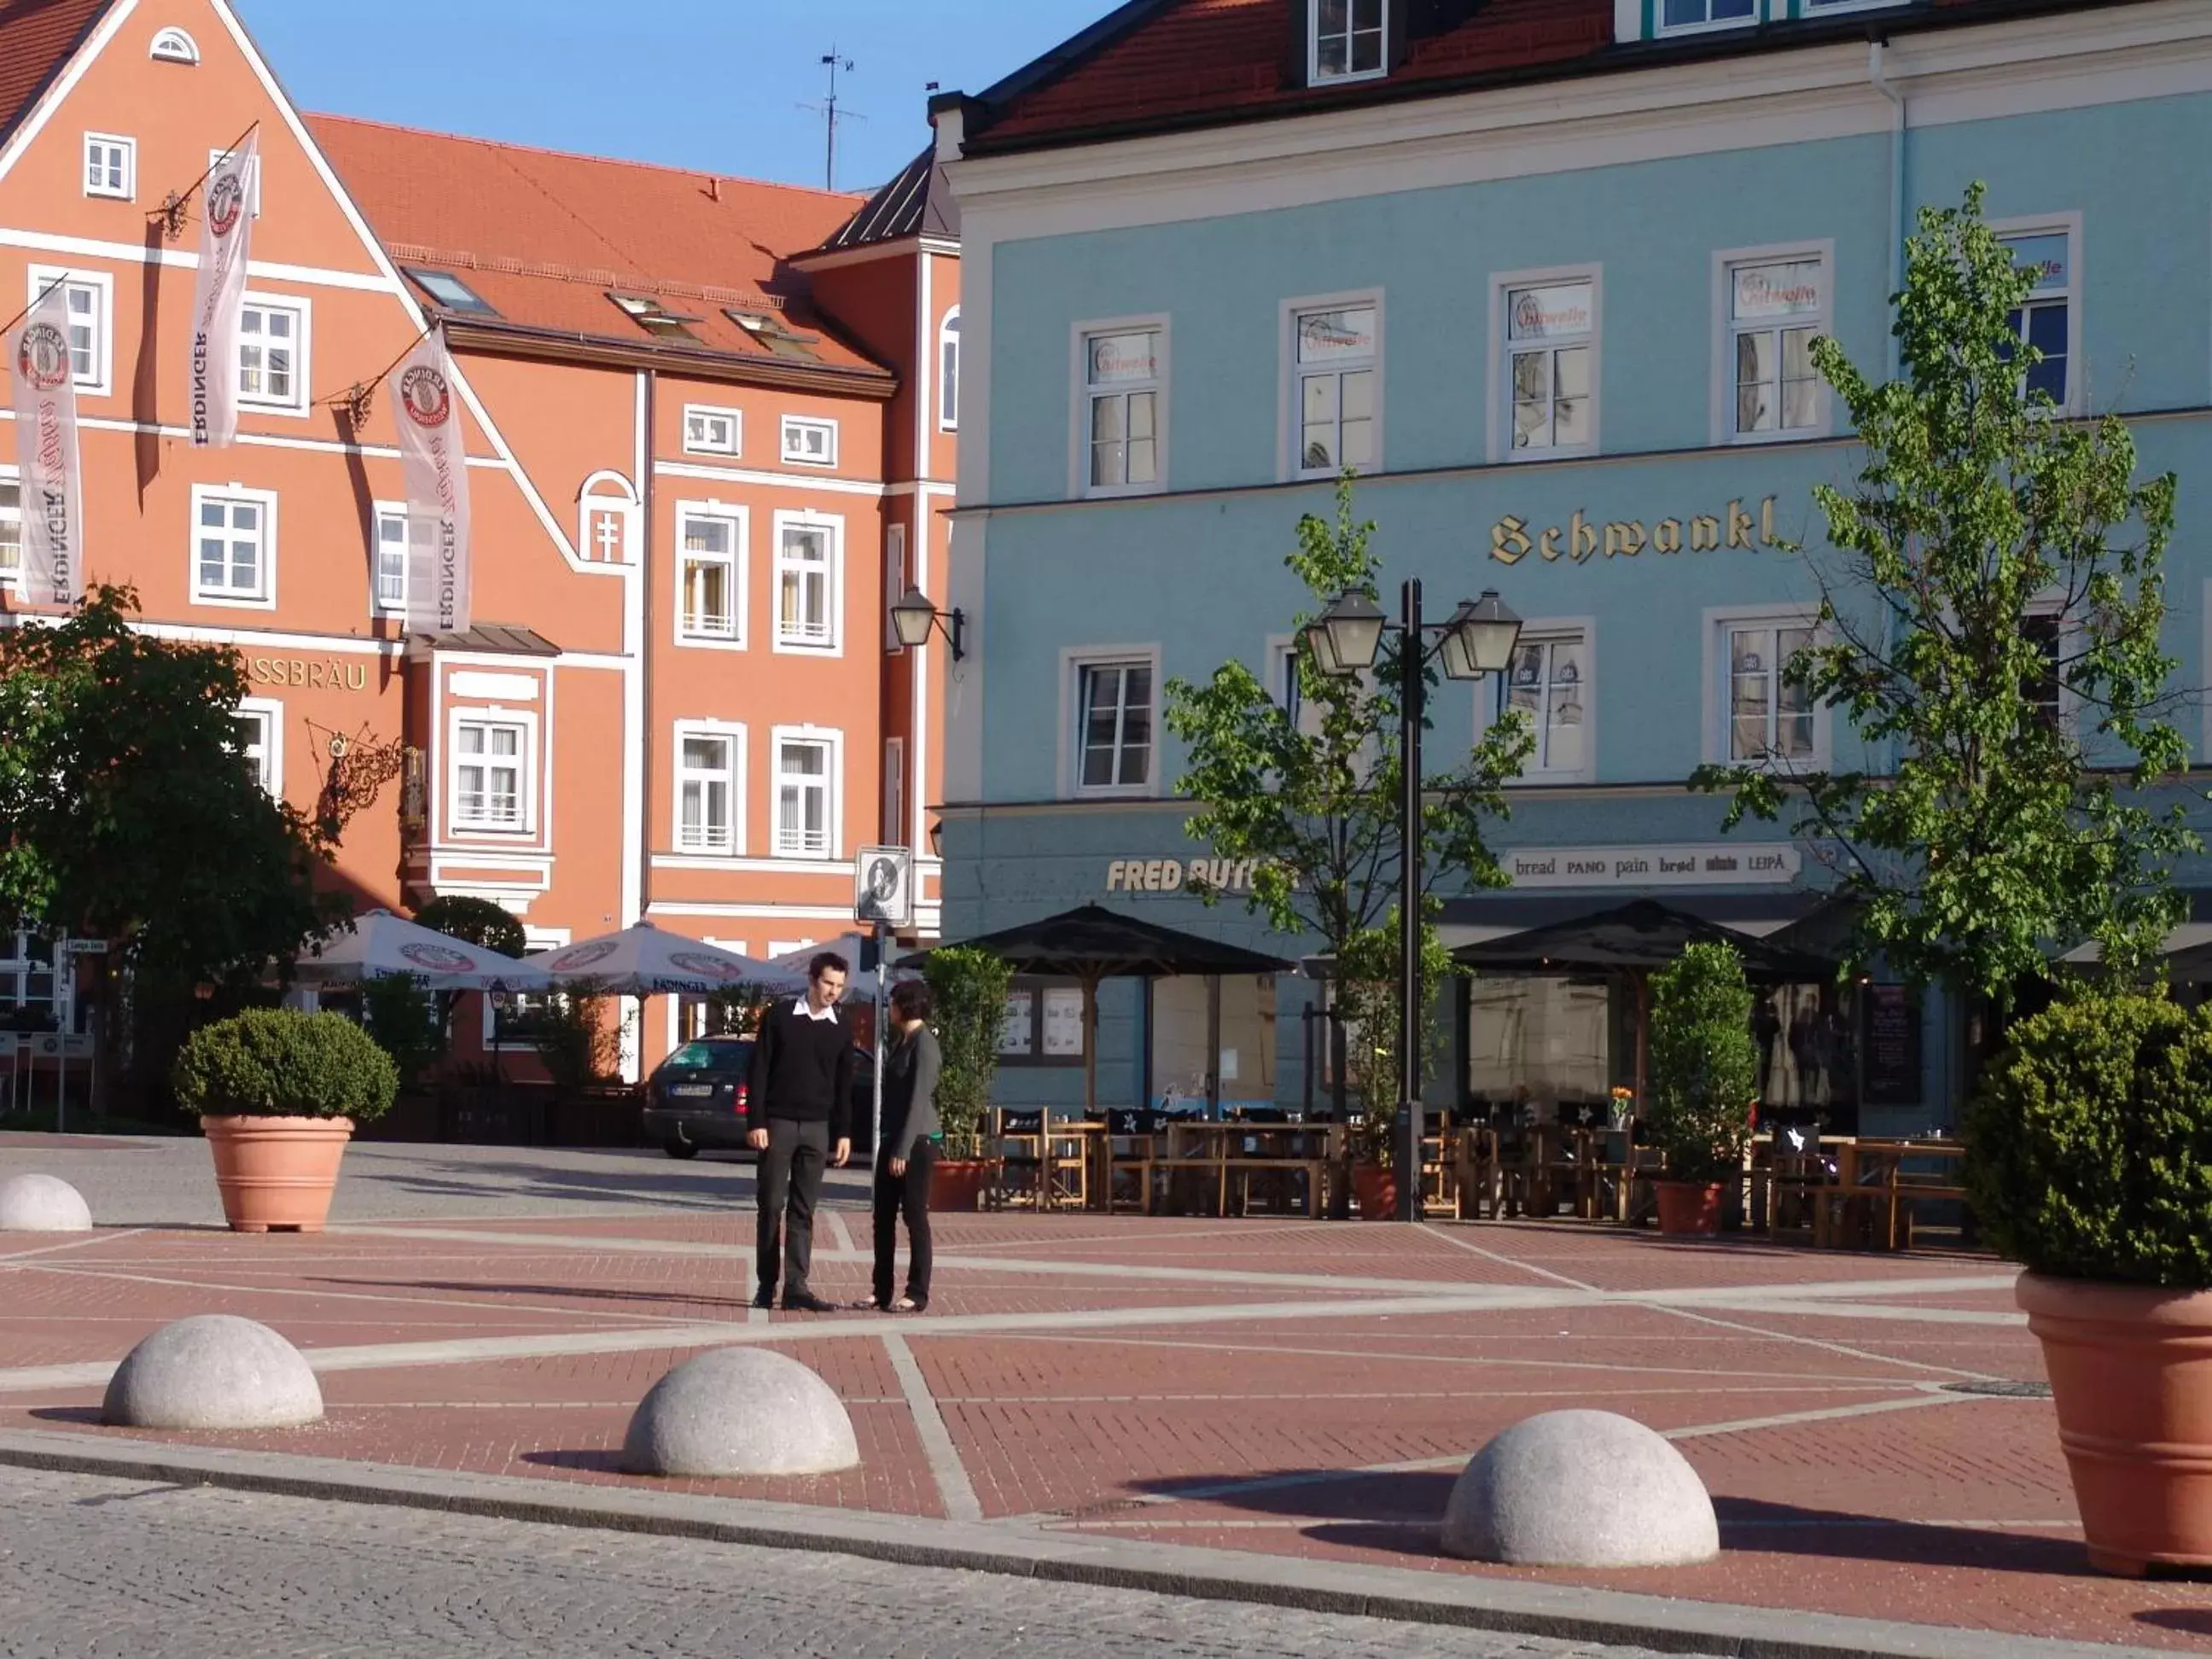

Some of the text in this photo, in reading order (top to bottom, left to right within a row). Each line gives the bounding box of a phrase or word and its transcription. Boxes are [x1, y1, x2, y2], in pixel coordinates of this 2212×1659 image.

[1488, 494, 1778, 567] Schwankl
[245, 655, 367, 690] ISSBRÄU
[1106, 859, 1182, 892] FRED
[1515, 857, 1557, 876] bread
[1567, 860, 1606, 875] PANO
[1615, 857, 1649, 879] pain
